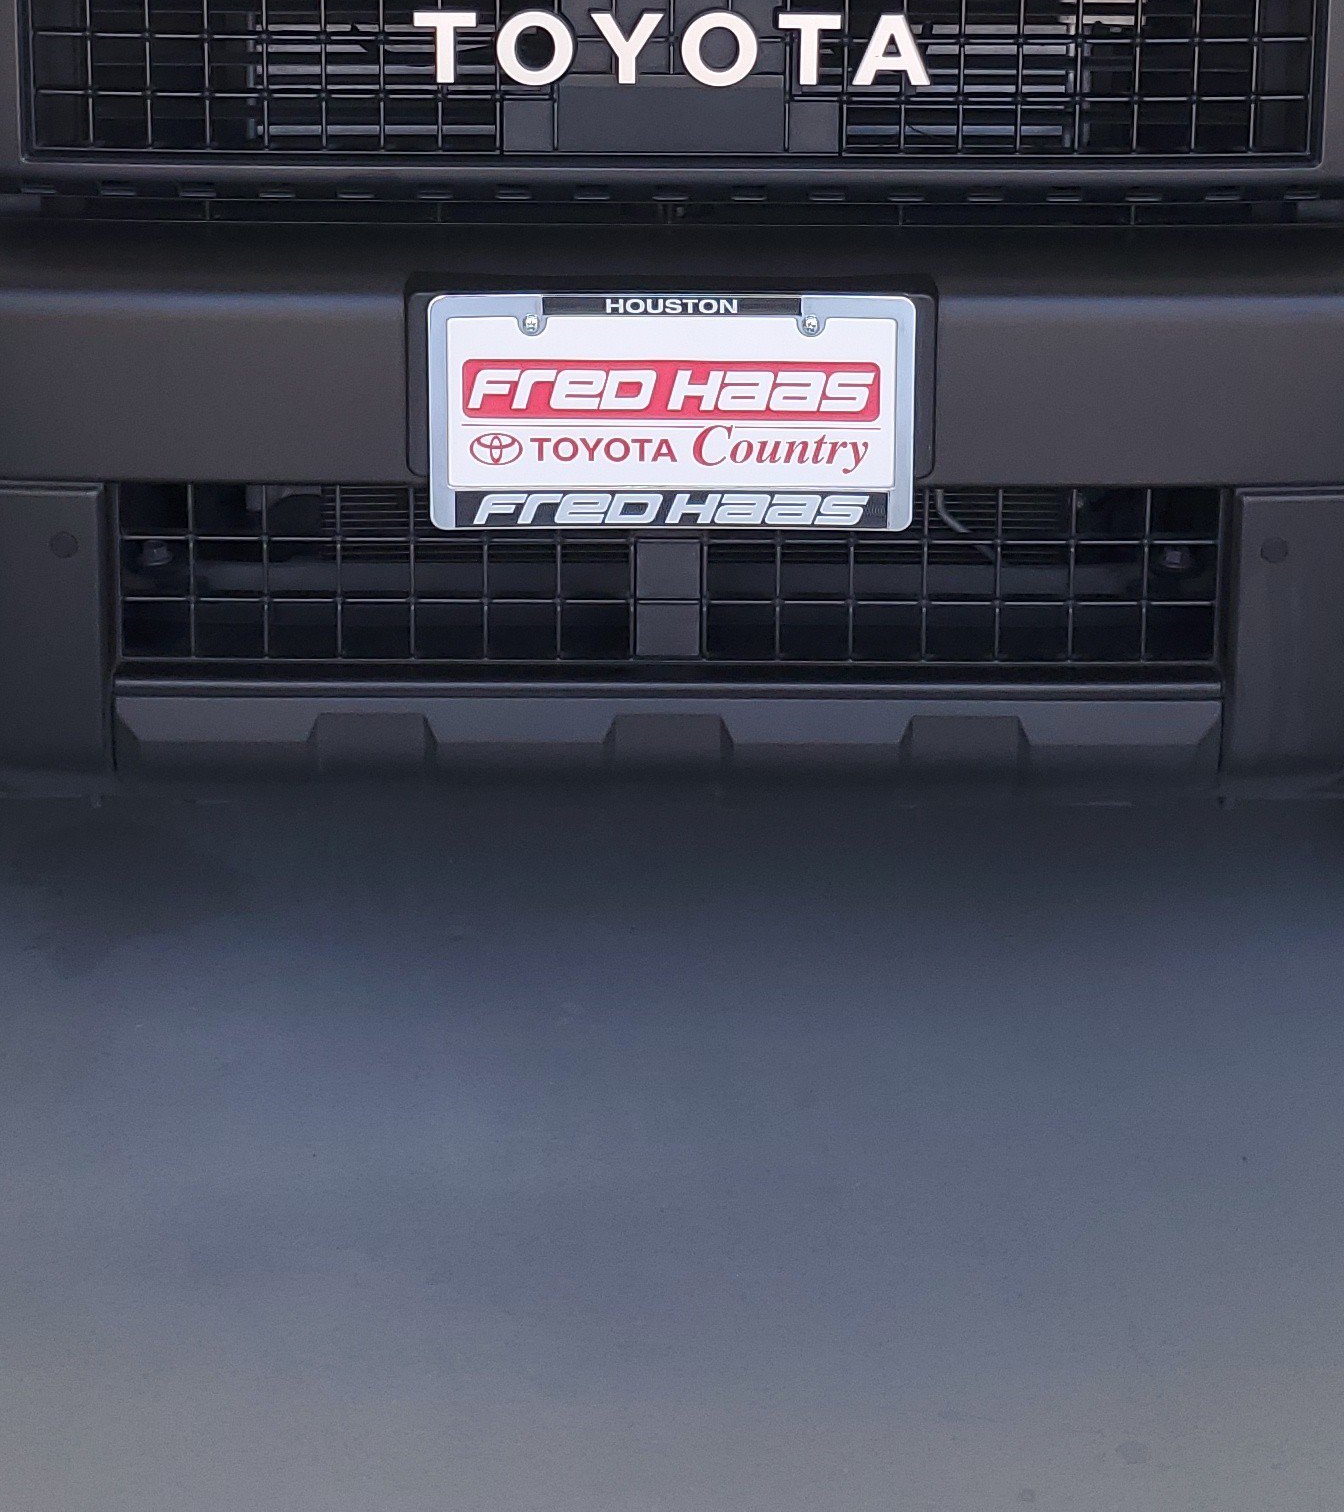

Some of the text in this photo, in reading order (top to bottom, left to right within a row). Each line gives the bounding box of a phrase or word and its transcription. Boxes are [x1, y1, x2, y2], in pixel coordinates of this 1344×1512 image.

[412, 8, 932, 88] TOYOTA
[605, 297, 739, 315] HOUSTON
[529, 423, 869, 474] TOYOTA Country
